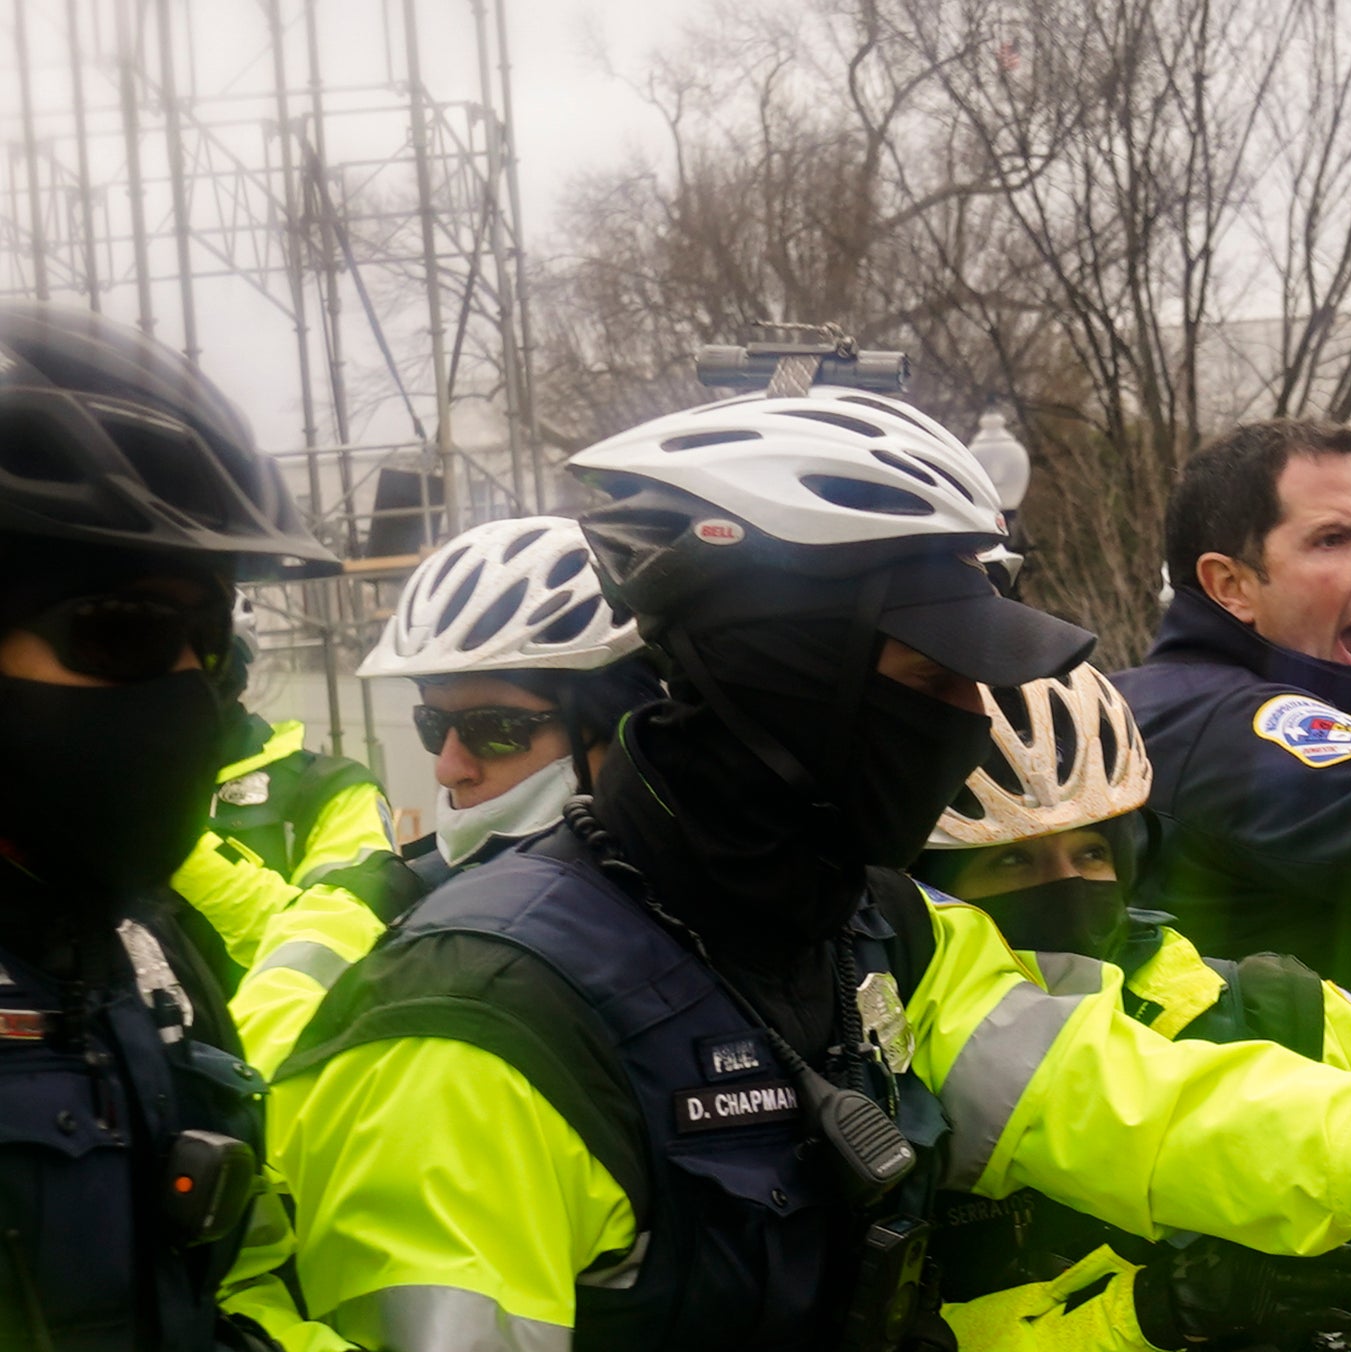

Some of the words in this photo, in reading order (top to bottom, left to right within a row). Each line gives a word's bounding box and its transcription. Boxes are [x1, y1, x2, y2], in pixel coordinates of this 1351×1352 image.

[702, 525, 735, 538] BELL
[687, 1096, 711, 1121] D.
[715, 1086, 800, 1117] CHAPMAN
